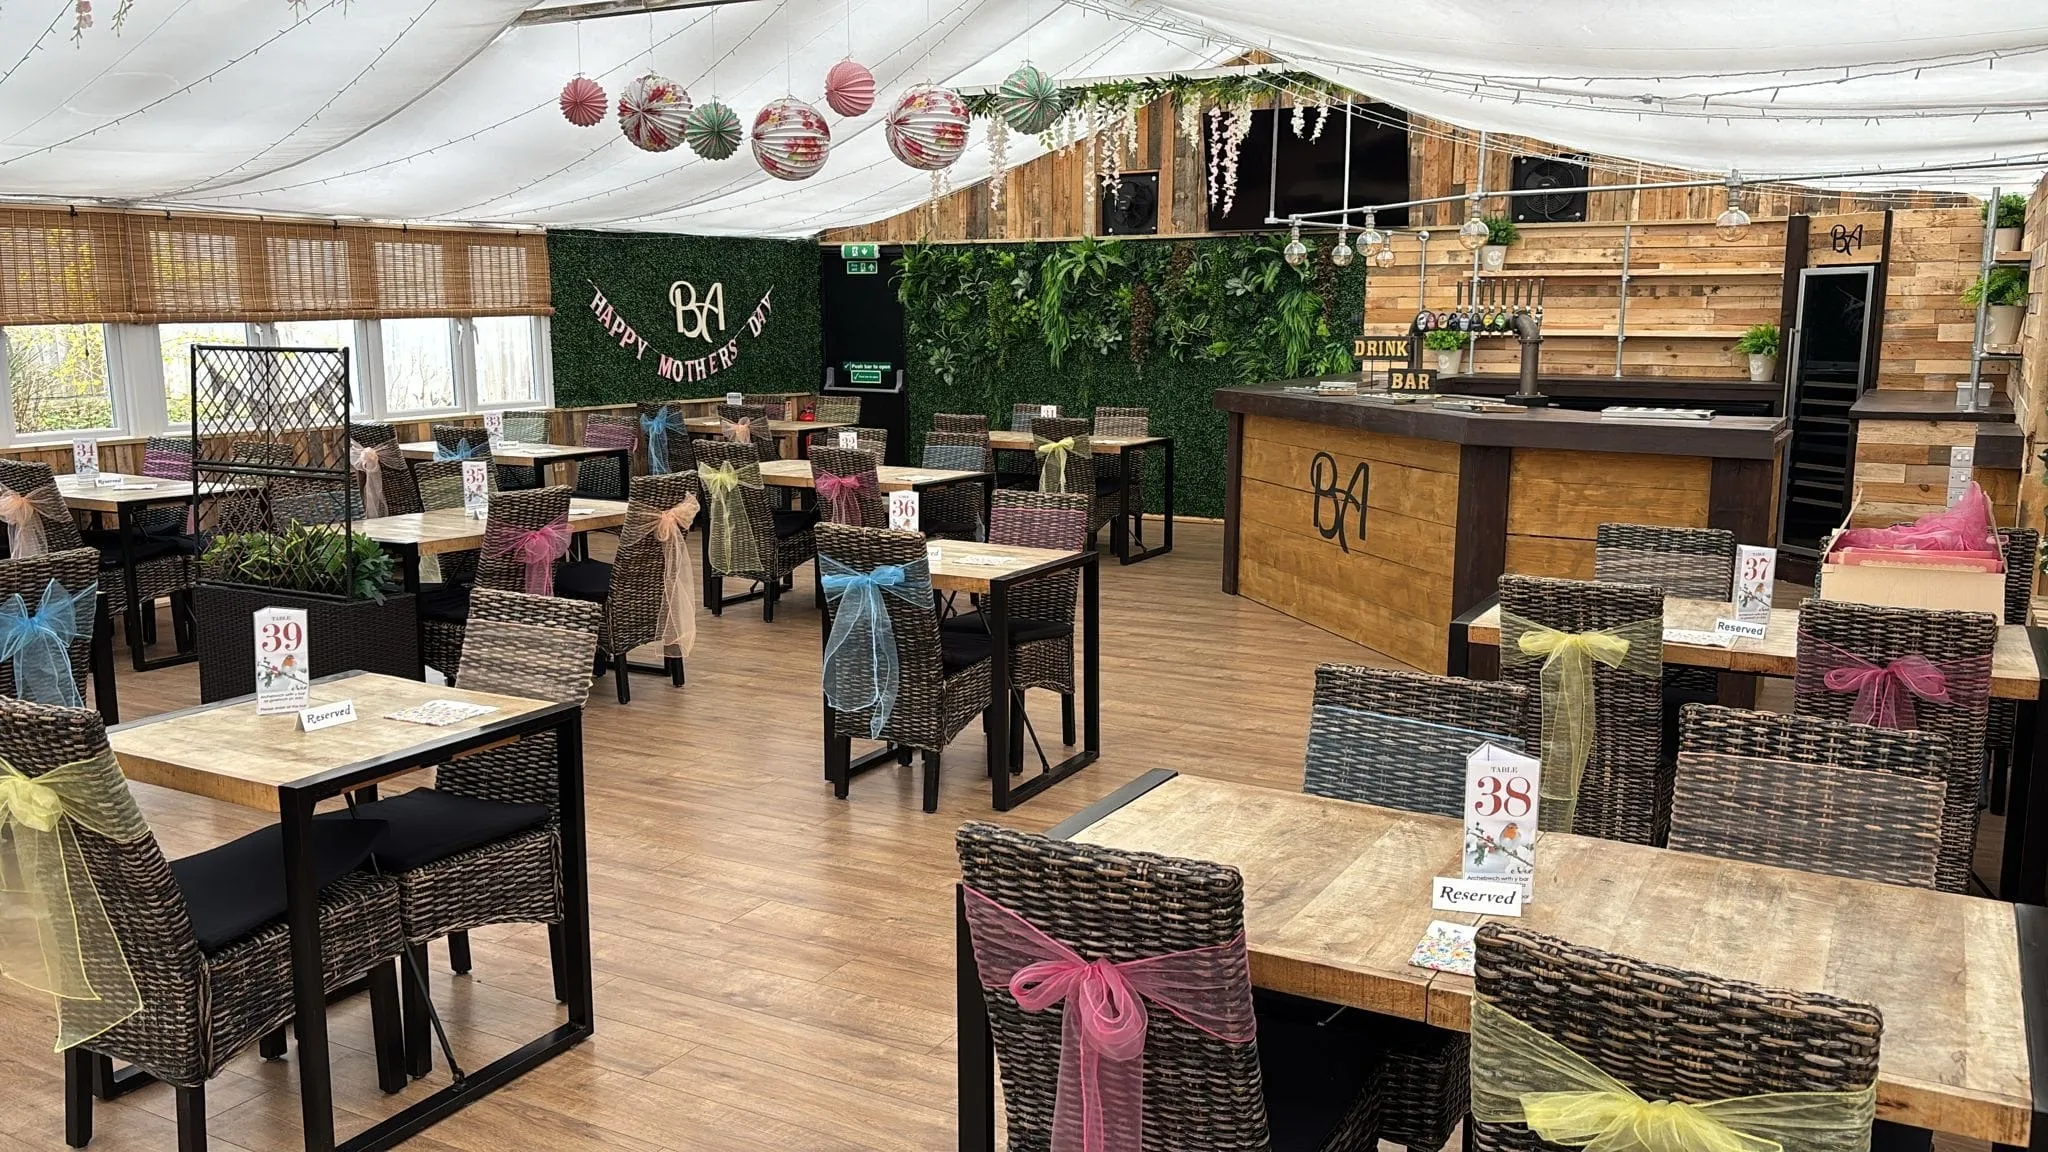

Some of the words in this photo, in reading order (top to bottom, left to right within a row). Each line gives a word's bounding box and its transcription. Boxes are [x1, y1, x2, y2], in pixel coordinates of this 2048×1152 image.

[1831, 224, 1864, 257] BA
[668, 280, 726, 344] BA
[589, 290, 648, 360] HAPPY
[657, 339, 738, 382] MOTHERS
[748, 295, 772, 338] DAY
[1354, 340, 1409, 357] DRINK
[1391, 372, 1430, 390] BAR
[486, 416, 501, 426] 33
[77, 443, 95, 456] 34
[466, 469, 485, 484] 35
[892, 499, 916, 518] 36
[1310, 451, 1370, 555] BA
[1744, 557, 1771, 581] 37
[261, 621, 303, 653] 39
[1717, 621, 1764, 636] Reserved
[307, 704, 352, 725] Reserved
[1490, 766, 1519, 774] TABLE
[1474, 775, 1532, 818] 38
[1439, 885, 1517, 905] Reserved
